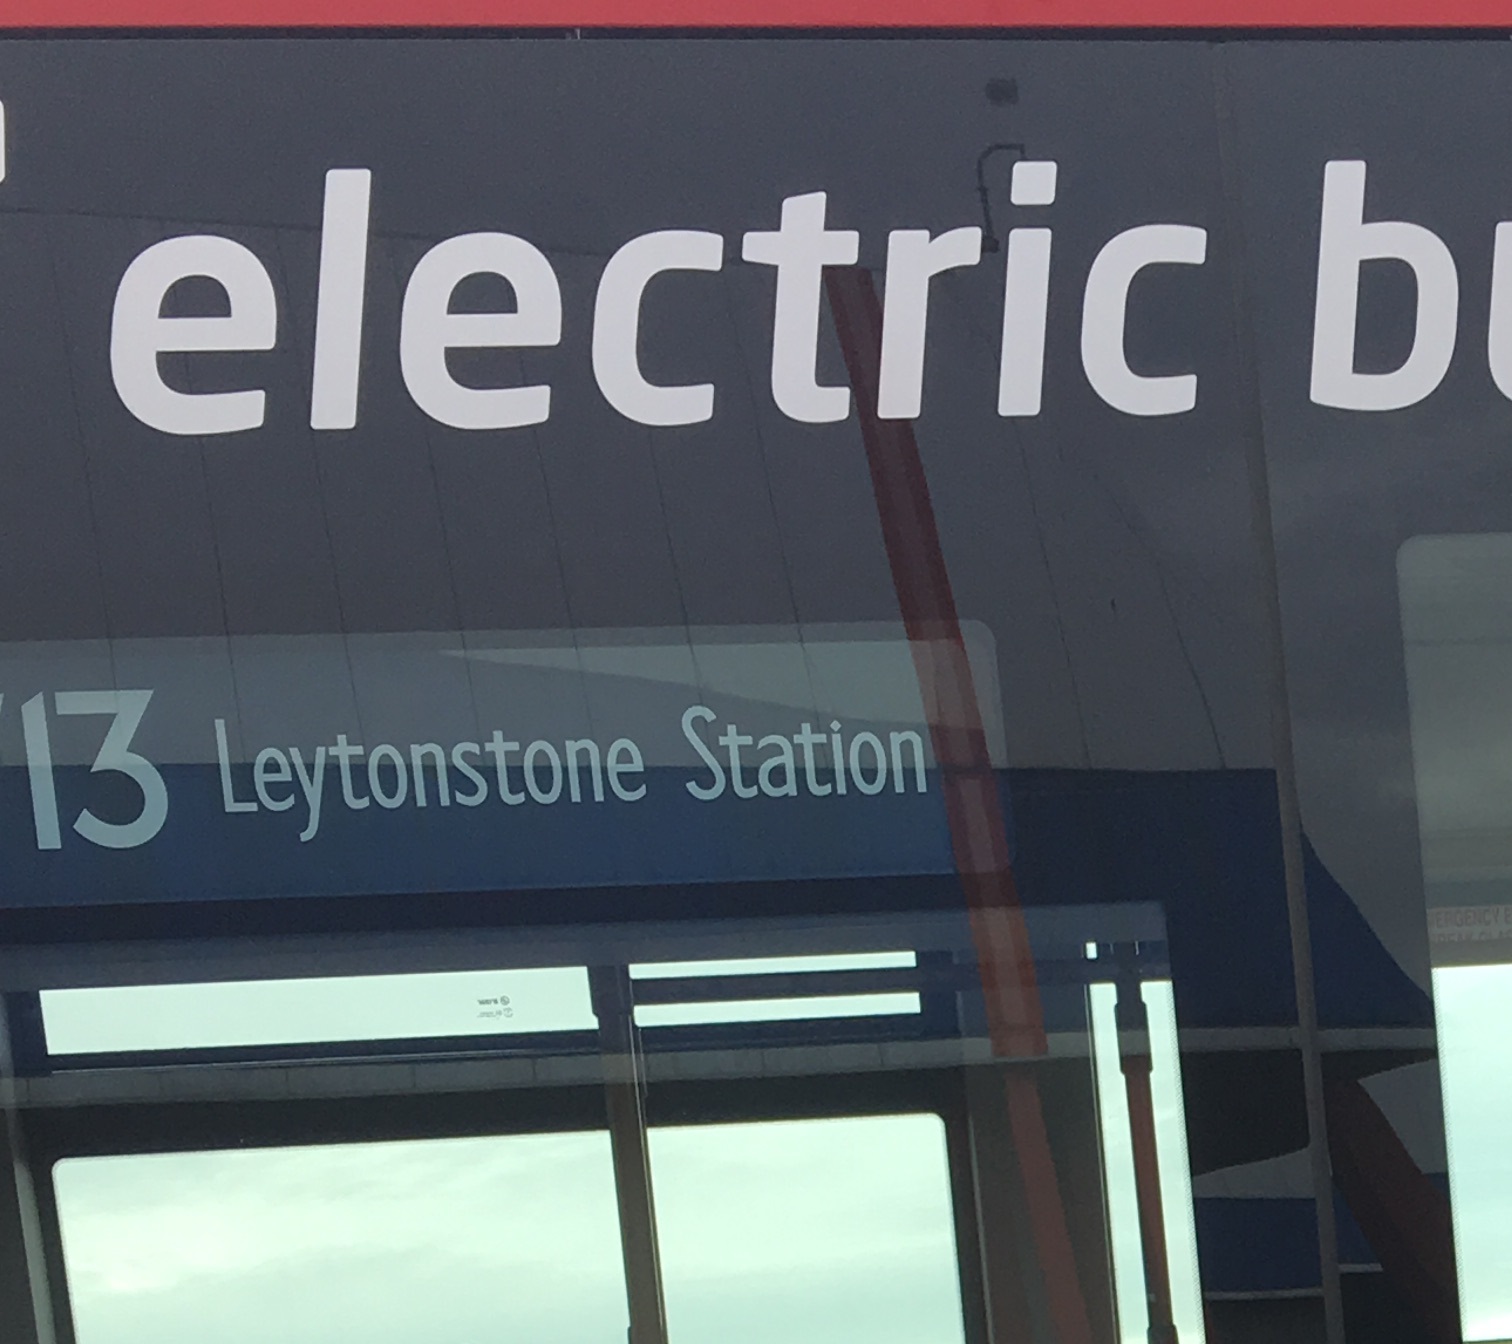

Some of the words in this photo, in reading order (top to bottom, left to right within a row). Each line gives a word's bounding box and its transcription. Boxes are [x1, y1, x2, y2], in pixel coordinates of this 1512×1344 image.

[109, 161, 1207, 436] electric
[0, 689, 168, 849] 13
[214, 718, 647, 842] Leytonstone
[681, 705, 929, 805] Station
